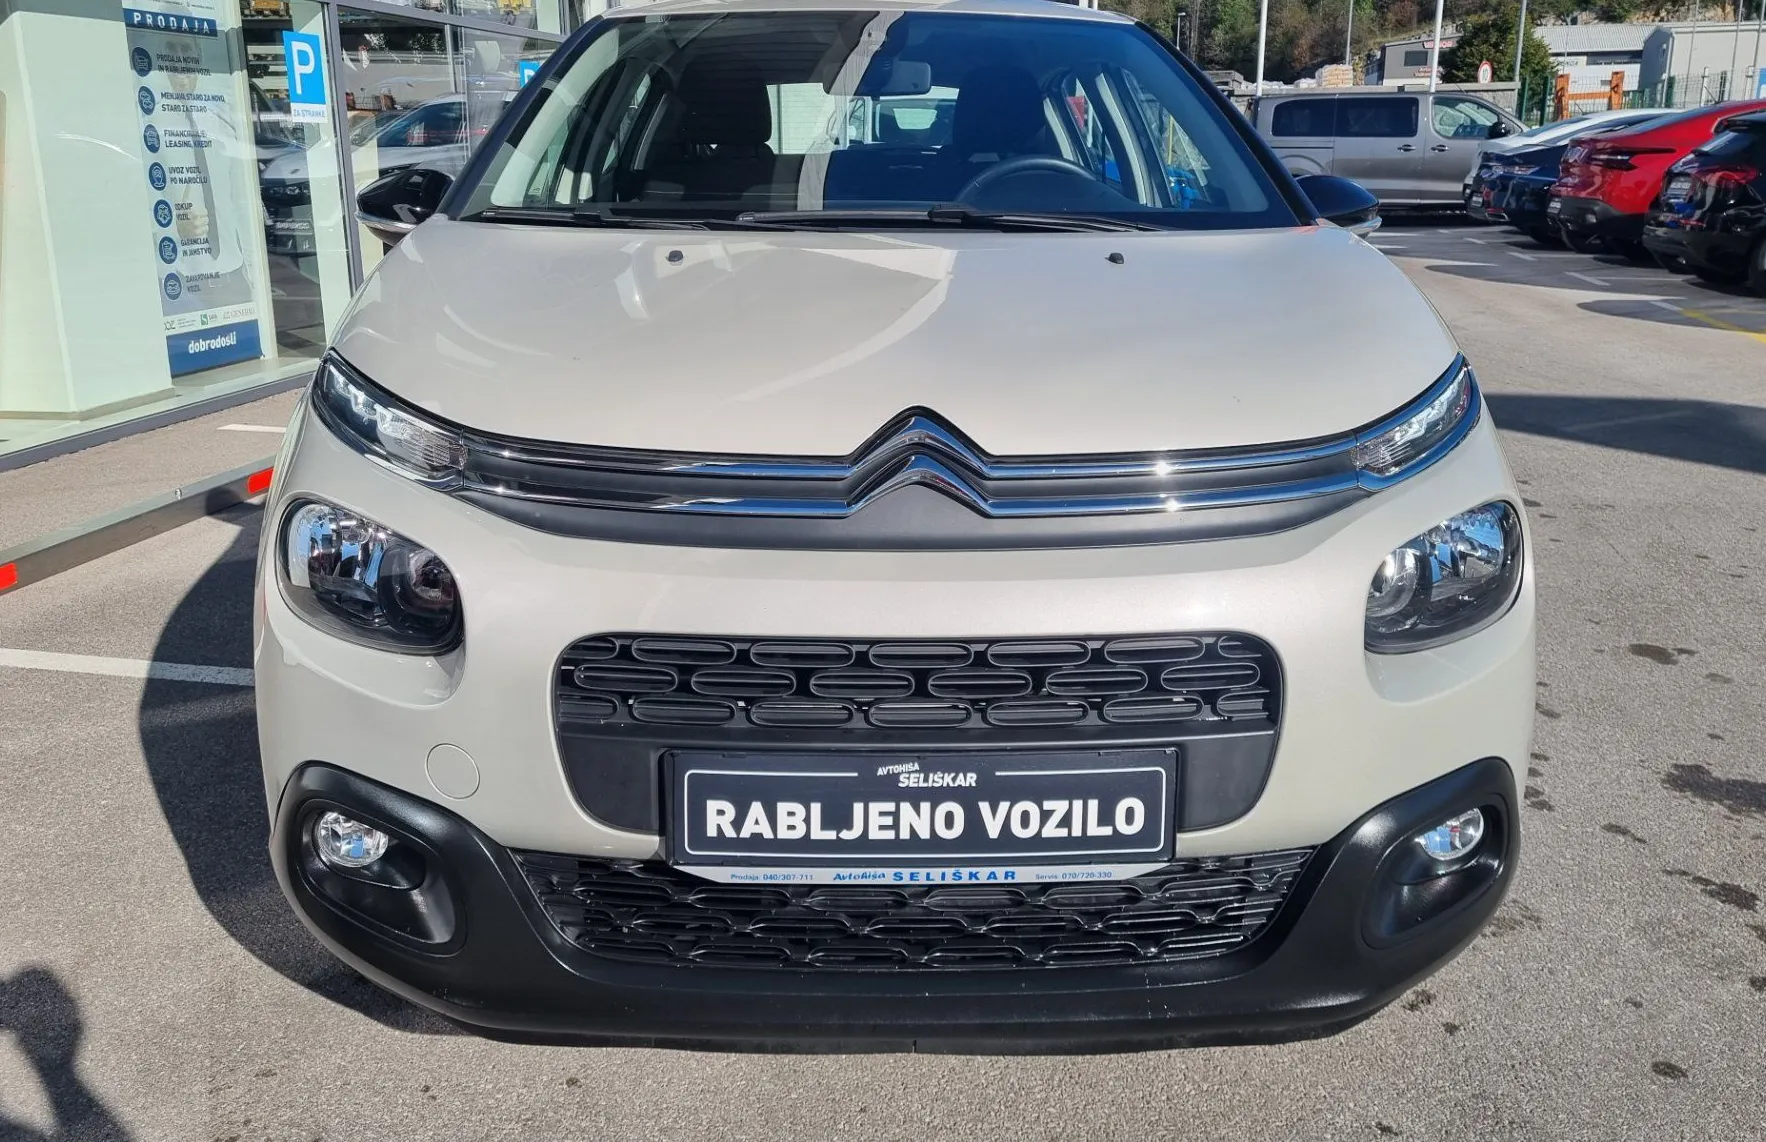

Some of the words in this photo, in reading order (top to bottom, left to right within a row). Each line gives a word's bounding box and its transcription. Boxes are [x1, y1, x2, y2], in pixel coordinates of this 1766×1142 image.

[133, 12, 210, 34] PRODAJA
[156, 53, 182, 64] PRODAJA
[291, 41, 315, 95] P
[187, 93, 203, 102] STARO
[203, 94, 211, 102] ZA
[162, 104, 180, 112] STARO
[181, 104, 190, 113] ZA
[190, 105, 208, 113] STARO
[169, 166, 184, 175] UVOZ
[186, 166, 201, 175] VOZIL
[170, 176, 178, 185] PO
[175, 202, 193, 211] ODKUP
[177, 212, 191, 221] VOZIL
[898, 771, 978, 787] SELIŠKAR
[705, 801, 965, 840] RABLJENO
[978, 797, 1146, 839] VOZILO
[762, 873, 815, 882] 040/307-711
[892, 869, 1016, 882] SELIŠKAR
[1061, 870, 1112, 880] 070/720-330
